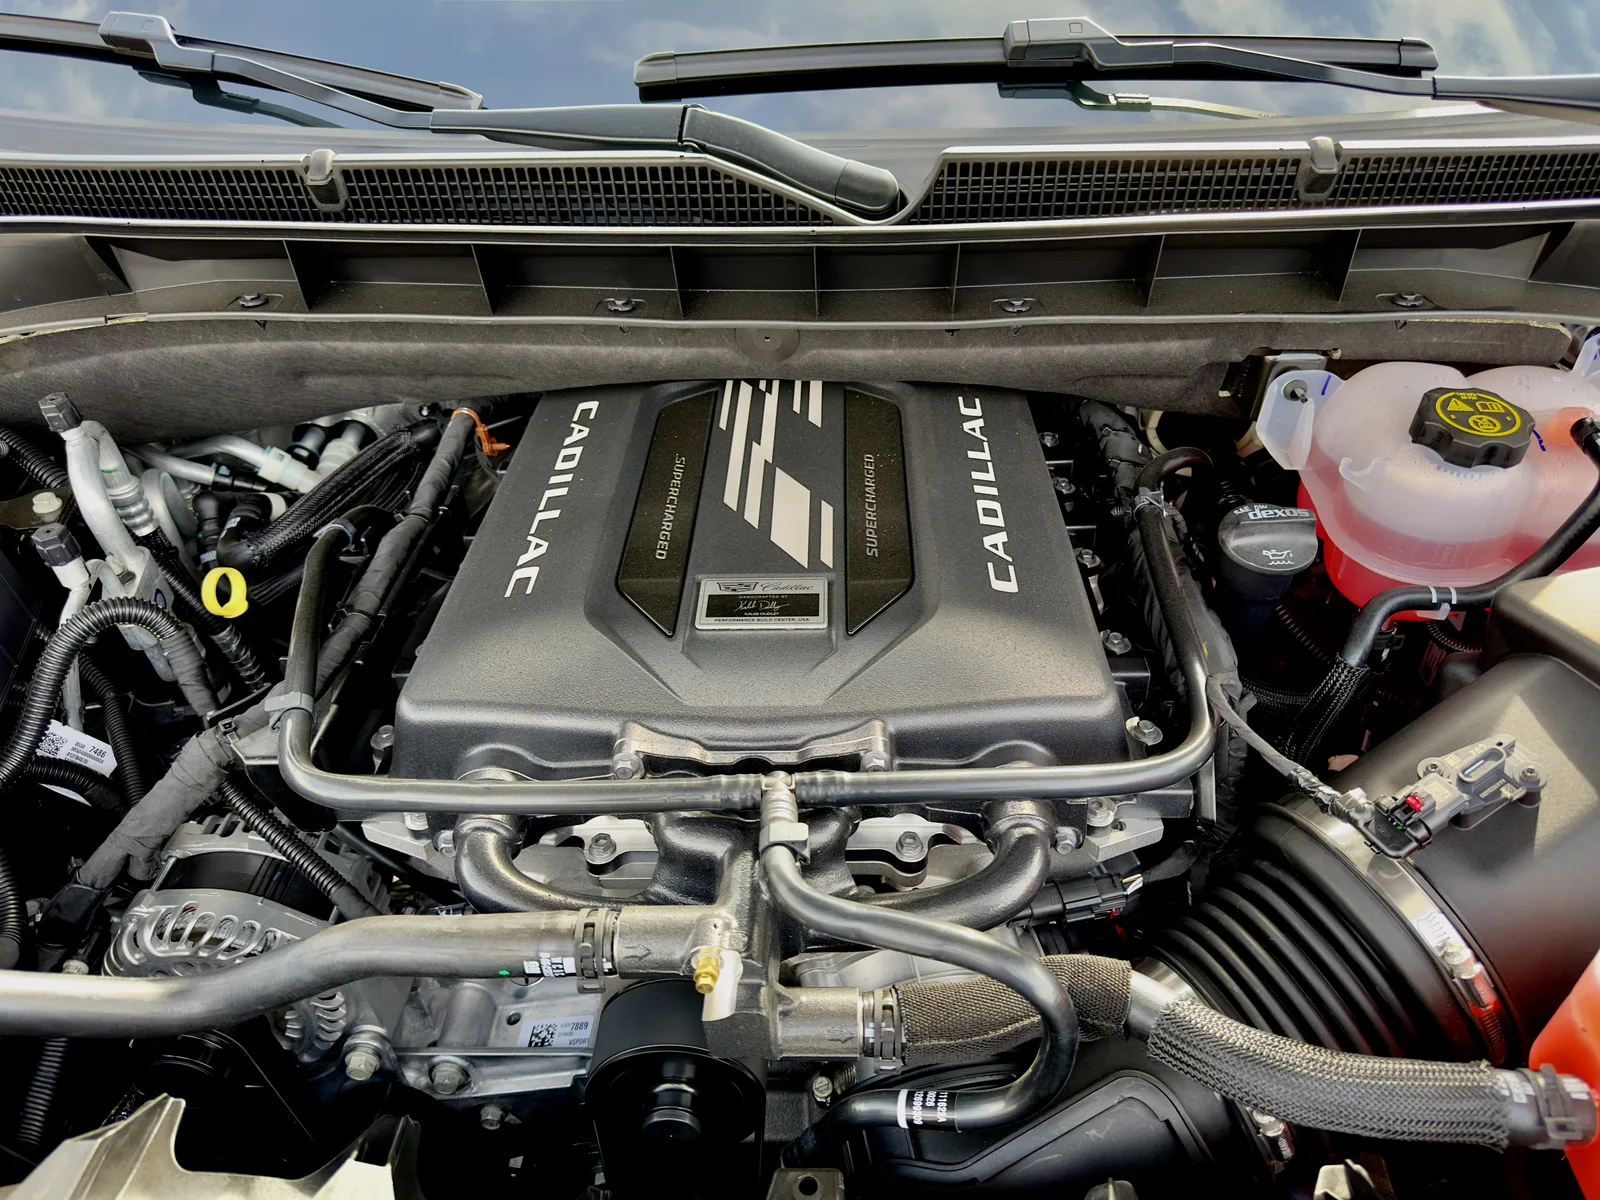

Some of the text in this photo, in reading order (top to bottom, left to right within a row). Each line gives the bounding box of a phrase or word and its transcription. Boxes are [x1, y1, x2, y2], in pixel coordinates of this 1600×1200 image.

[504, 401, 599, 598] CADILLAC
[655, 456, 685, 560] SUPERCHARGED
[864, 454, 879, 557] SUPERCHARGED
[958, 396, 1019, 593] CADILLAC
[1248, 507, 1309, 519] dexos
[760, 582, 814, 592] Cadillac
[90, 746, 107, 758] 7486
[570, 1021, 589, 1032] 7889
